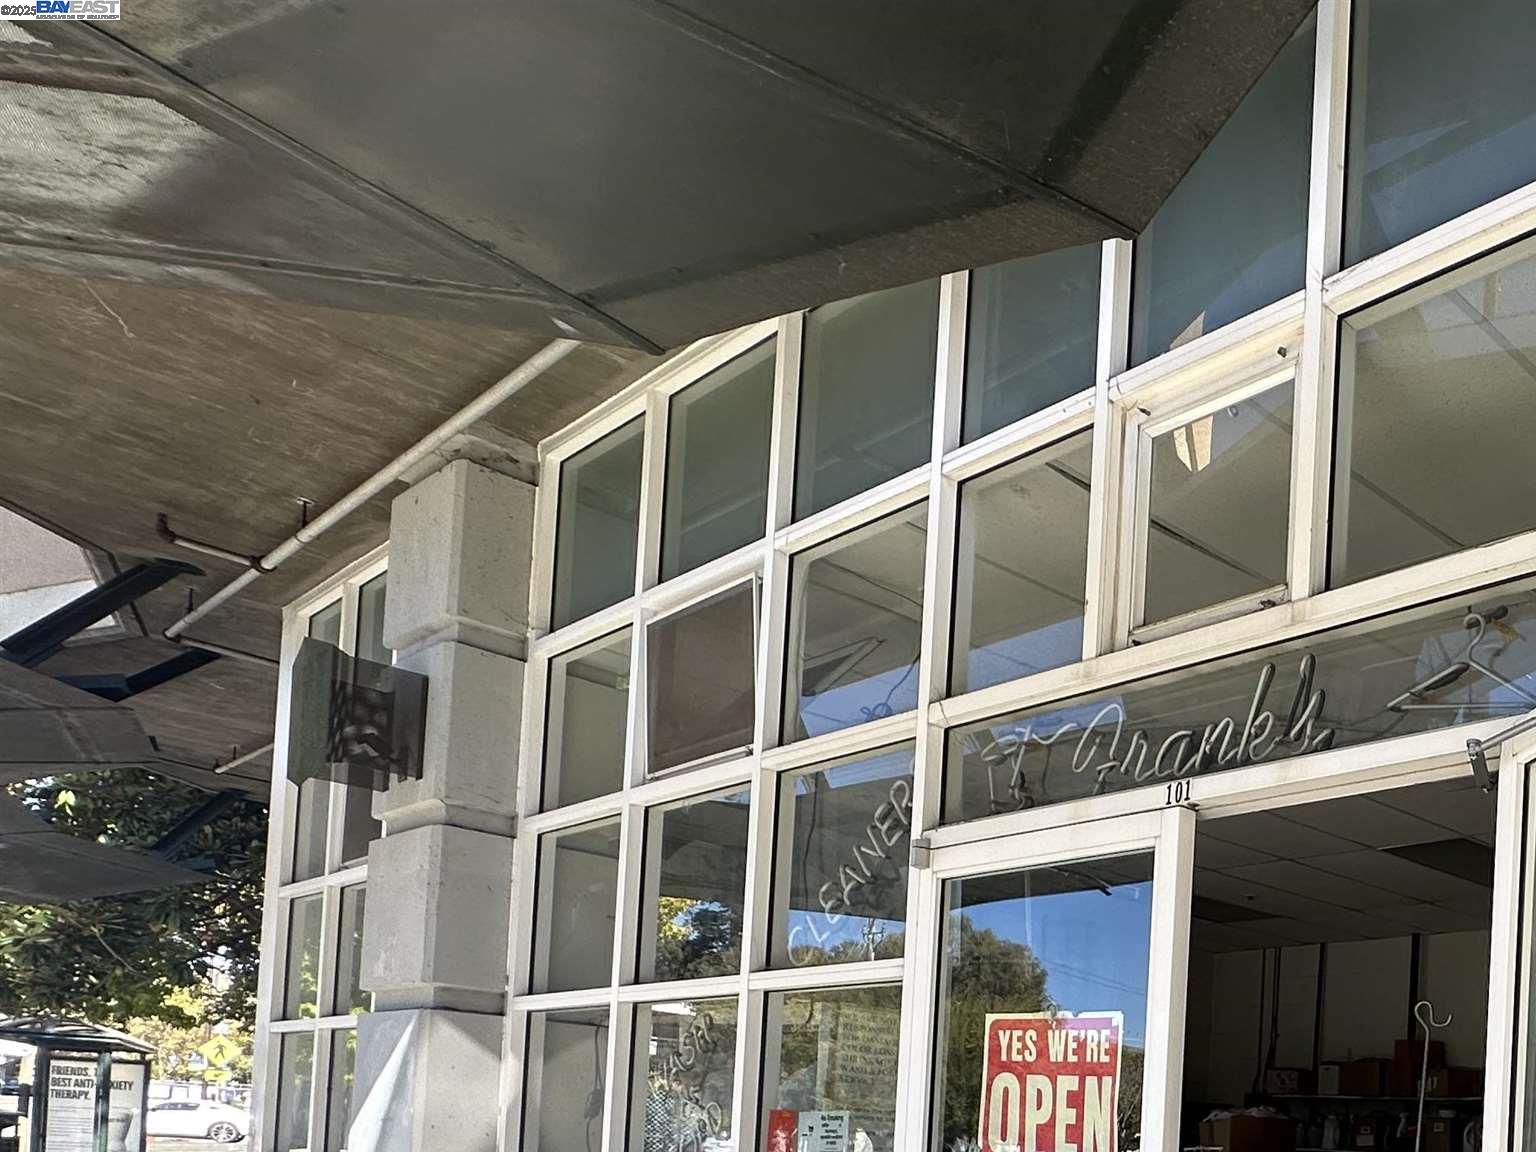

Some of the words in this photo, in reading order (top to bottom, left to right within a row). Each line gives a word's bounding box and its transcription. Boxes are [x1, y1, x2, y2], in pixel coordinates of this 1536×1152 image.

[1165, 780, 1192, 805] 101
[998, 1029, 1037, 1062] YES
[1048, 1029, 1111, 1062] WE'RE
[51, 1078, 72, 1088] BEST
